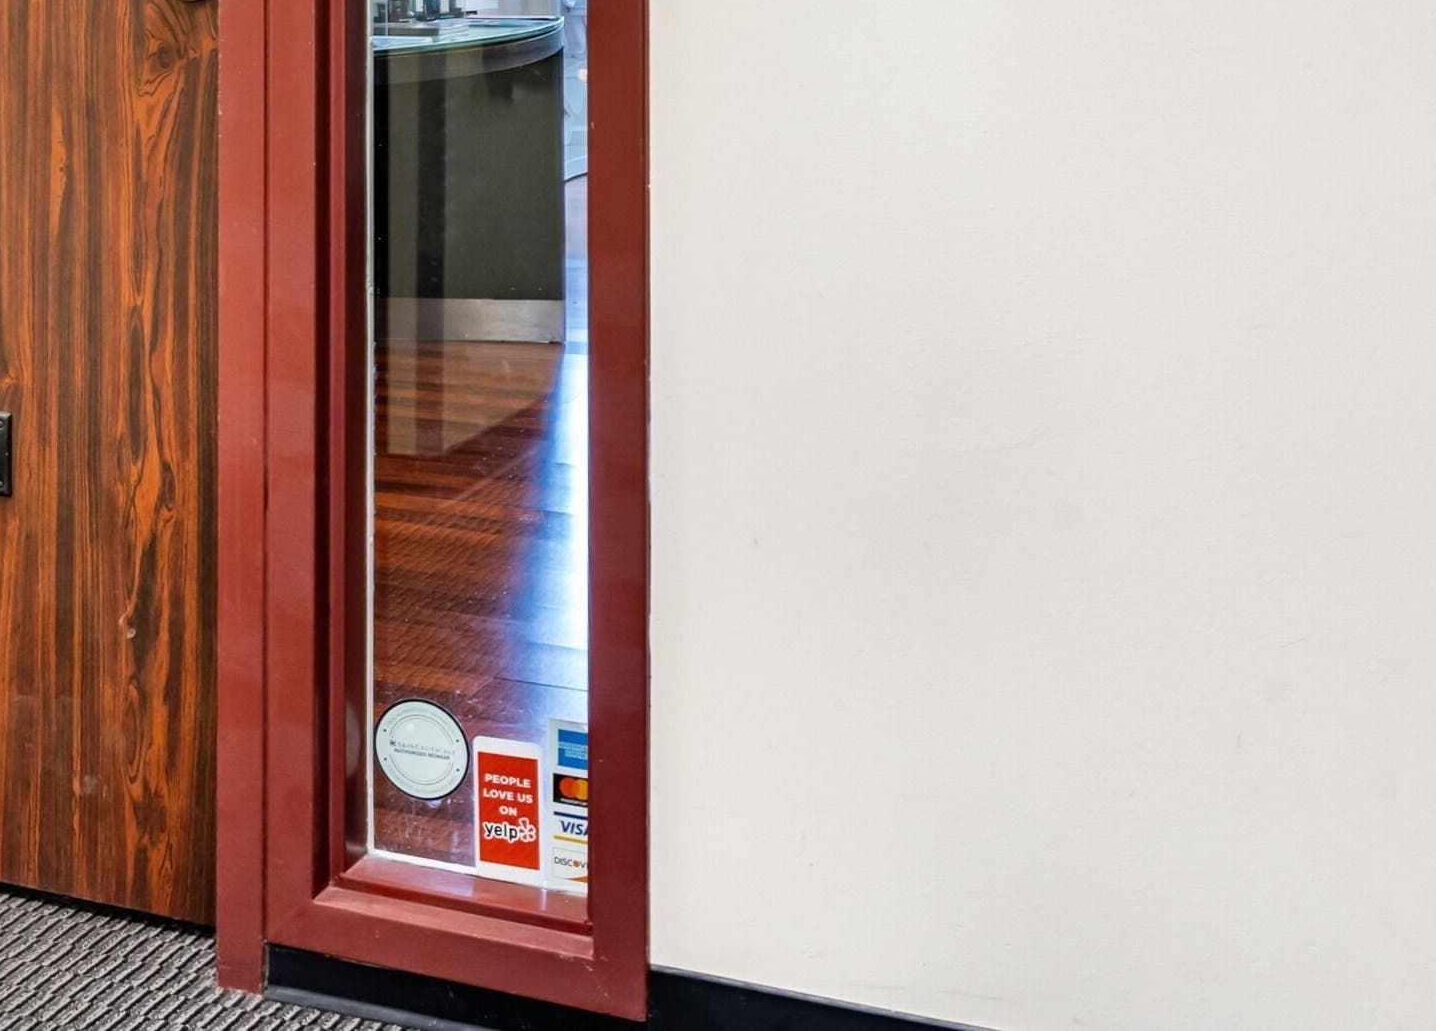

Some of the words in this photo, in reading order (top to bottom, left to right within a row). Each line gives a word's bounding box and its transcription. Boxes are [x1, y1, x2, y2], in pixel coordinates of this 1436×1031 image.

[484, 773, 531, 789] PEOPLE
[483, 788, 515, 801] LOVE
[517, 792, 534, 804] US
[499, 805, 517, 817] ON
[483, 822, 519, 843] yelp
